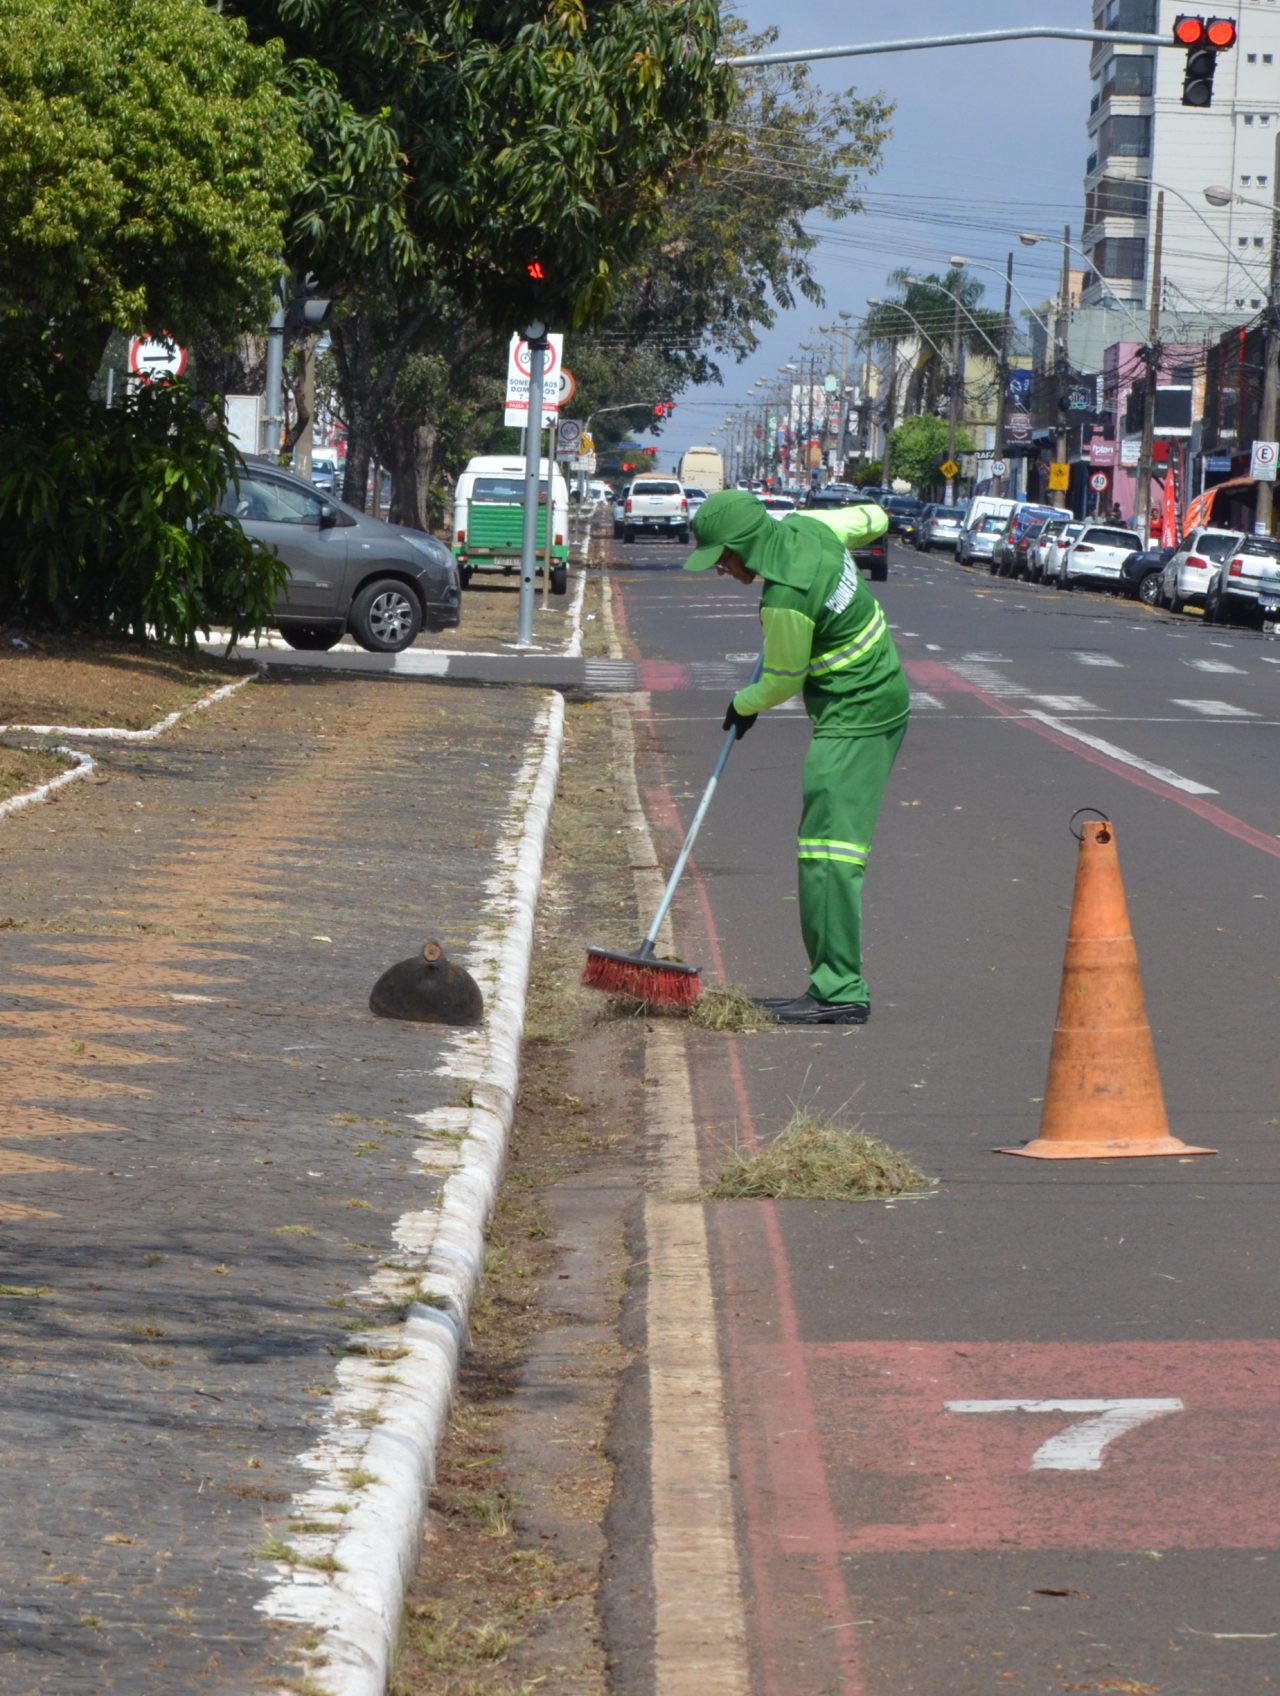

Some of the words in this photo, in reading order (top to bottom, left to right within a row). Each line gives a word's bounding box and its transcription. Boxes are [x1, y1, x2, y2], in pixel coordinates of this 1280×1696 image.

[511, 386, 555, 396] DOMOS
[1261, 448, 1268, 459] E
[1094, 475, 1105, 486] 40
